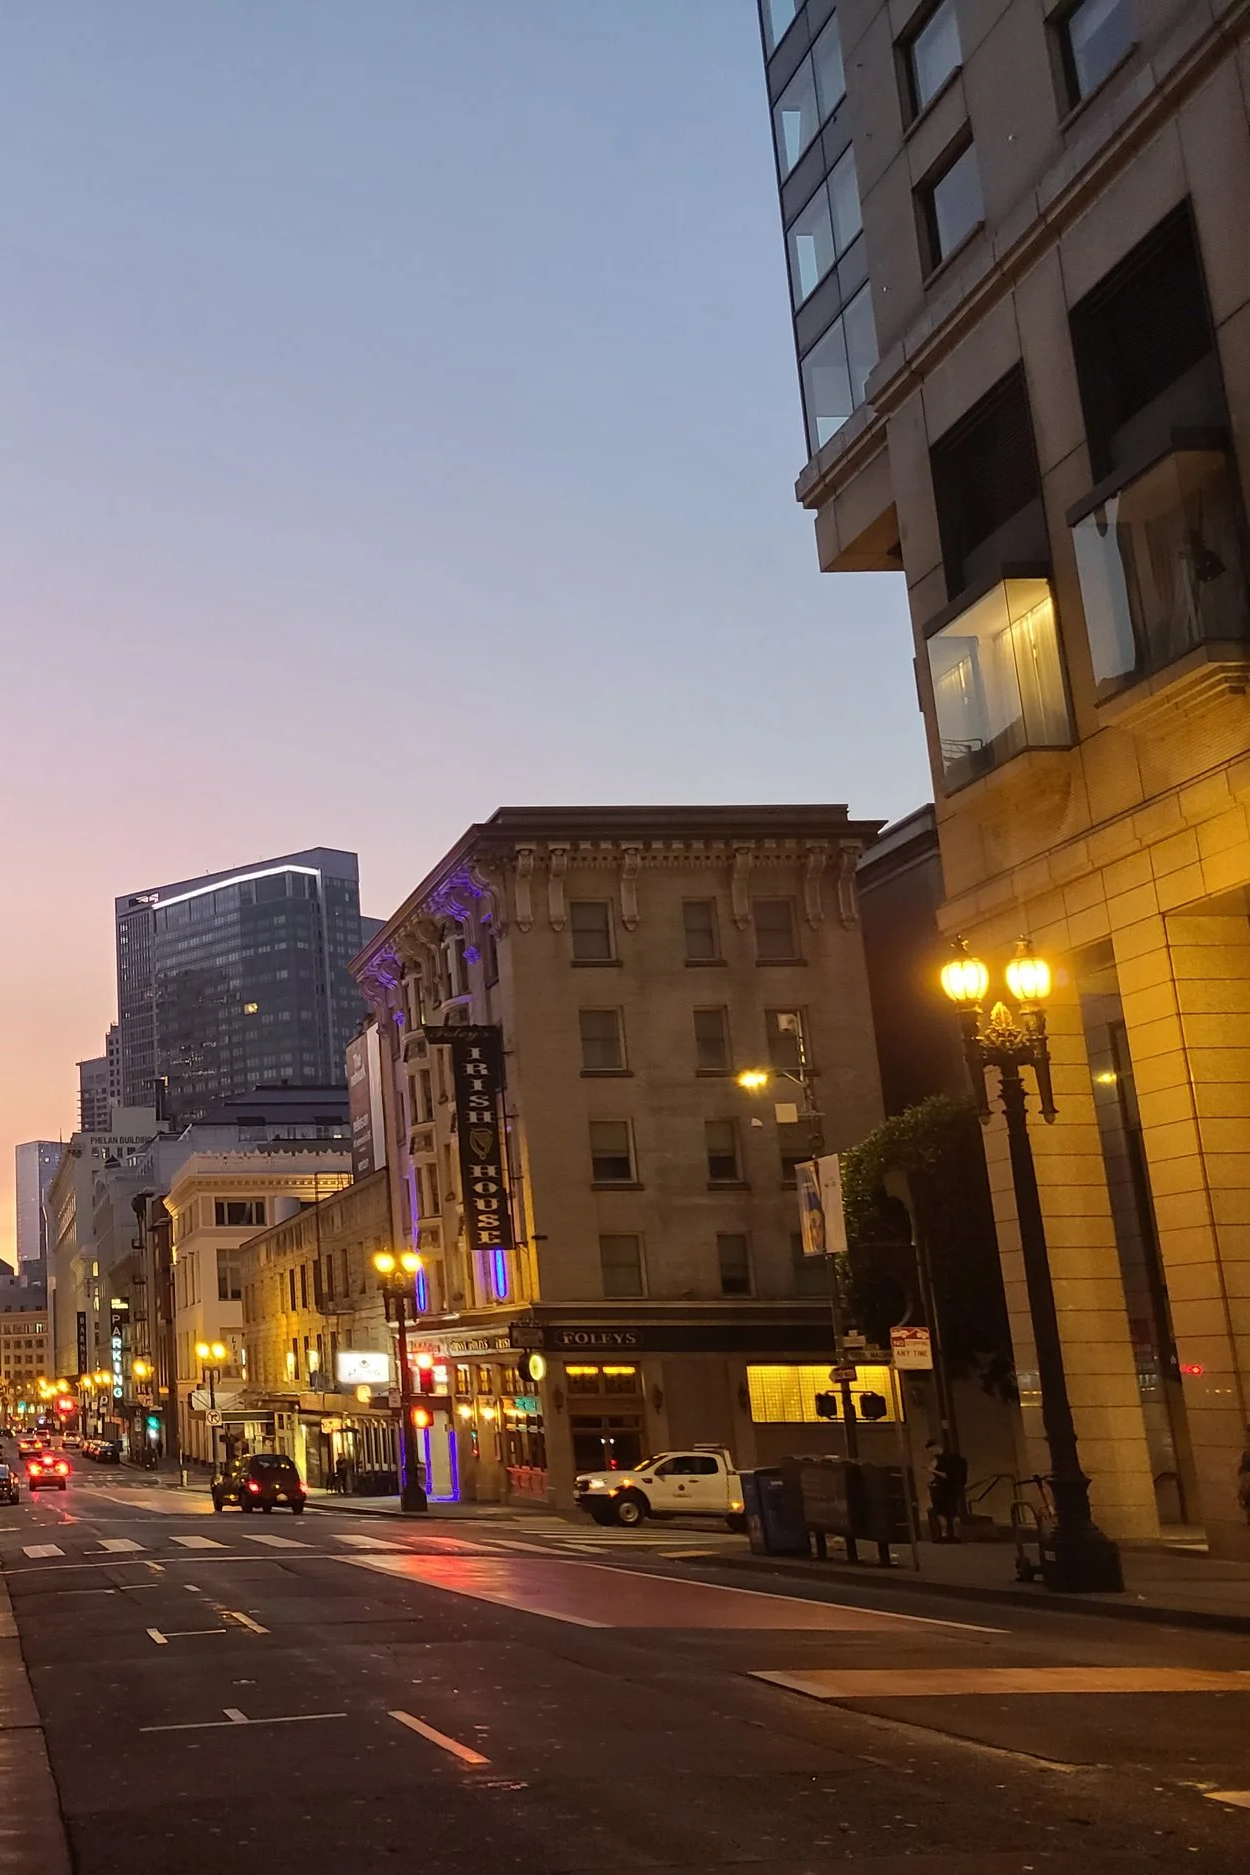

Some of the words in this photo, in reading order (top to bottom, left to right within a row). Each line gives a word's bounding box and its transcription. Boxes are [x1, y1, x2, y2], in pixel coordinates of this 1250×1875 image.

[463, 1047, 496, 1124] IRISH
[90, 1136, 118, 1144] PHELAN
[468, 1164, 502, 1245] HOUSE
[111, 1313, 124, 1399] PARKING
